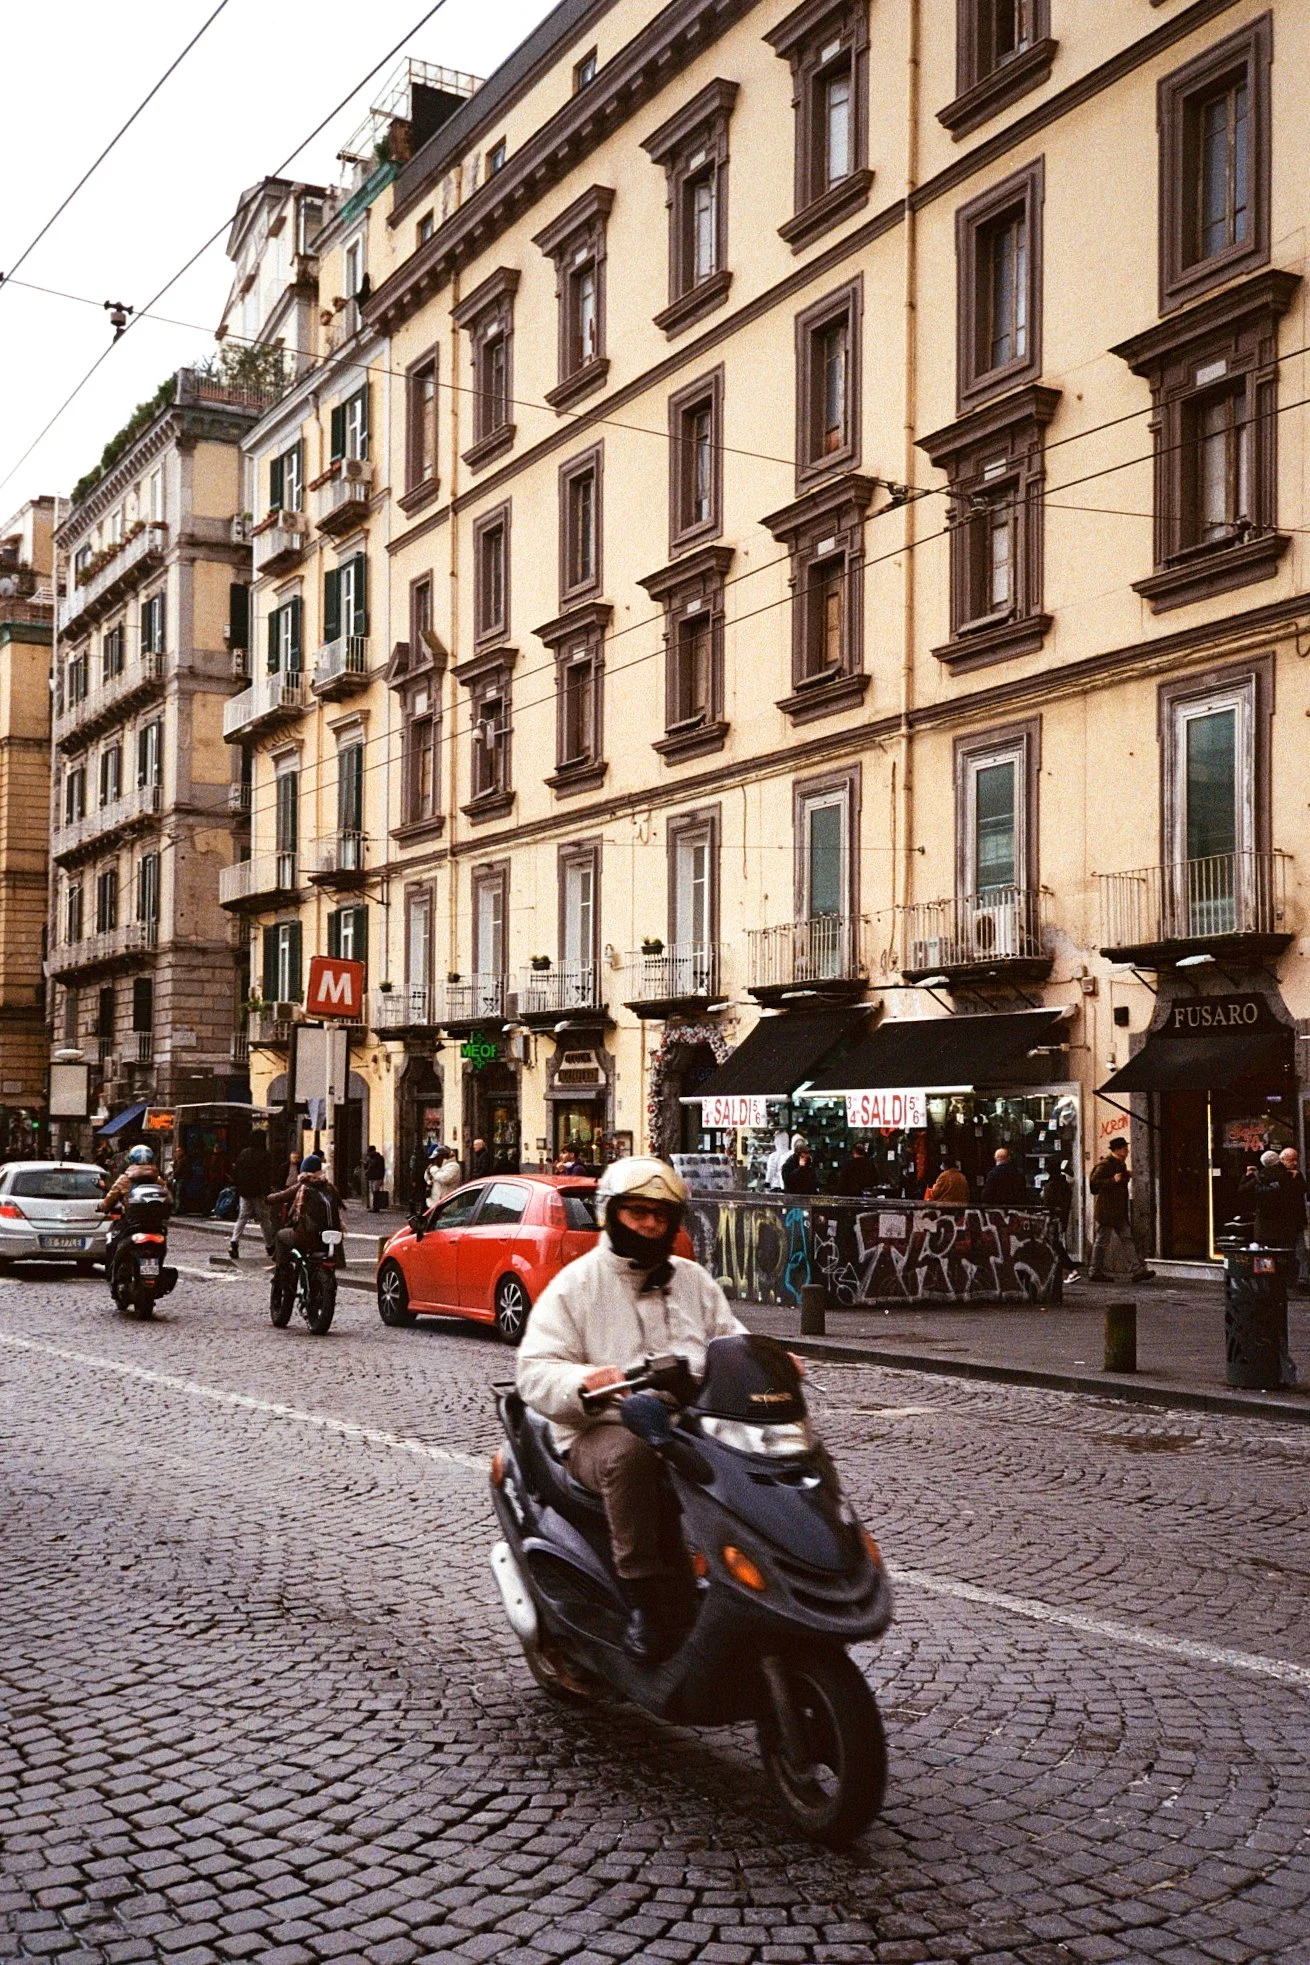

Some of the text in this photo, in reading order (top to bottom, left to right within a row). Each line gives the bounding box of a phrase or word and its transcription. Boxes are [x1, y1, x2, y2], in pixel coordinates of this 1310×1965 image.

[317, 970, 352, 1005] M
[1174, 1002, 1258, 1028] FUSARO
[714, 1098, 752, 1126] SALDI
[861, 1094, 907, 1125] SALDI
